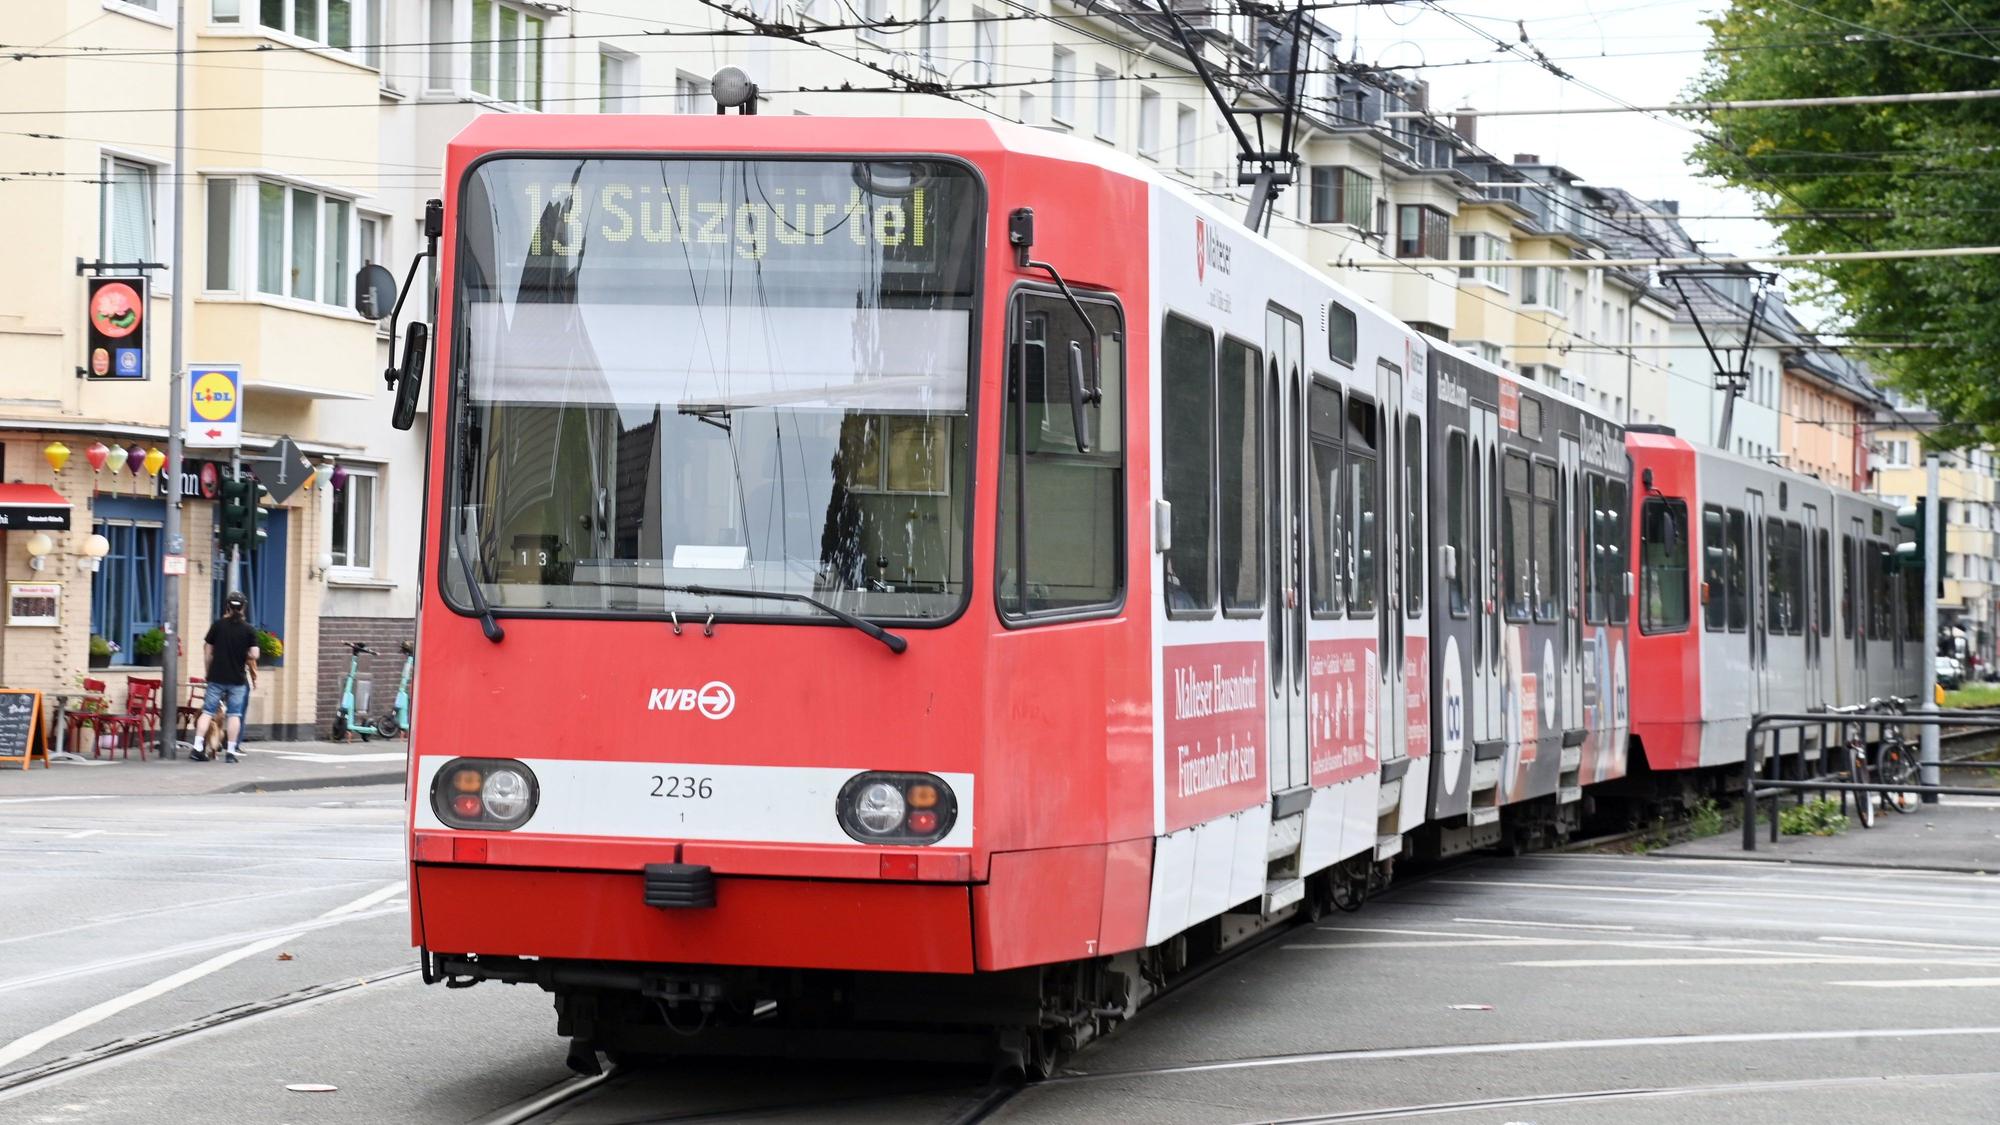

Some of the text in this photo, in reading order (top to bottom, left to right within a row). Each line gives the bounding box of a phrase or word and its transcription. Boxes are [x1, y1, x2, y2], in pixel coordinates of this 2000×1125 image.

[525, 182, 925, 259] 13 Sülzgürtel
[647, 688, 697, 711] KVB
[1175, 664, 1213, 720] Malteser
[1213, 659, 1257, 713] Hausnotruf
[650, 775, 713, 799] 2236
[1178, 736, 1229, 798] Füreinander
[1229, 733, 1240, 784] da
[1240, 731, 1256, 782] sein
